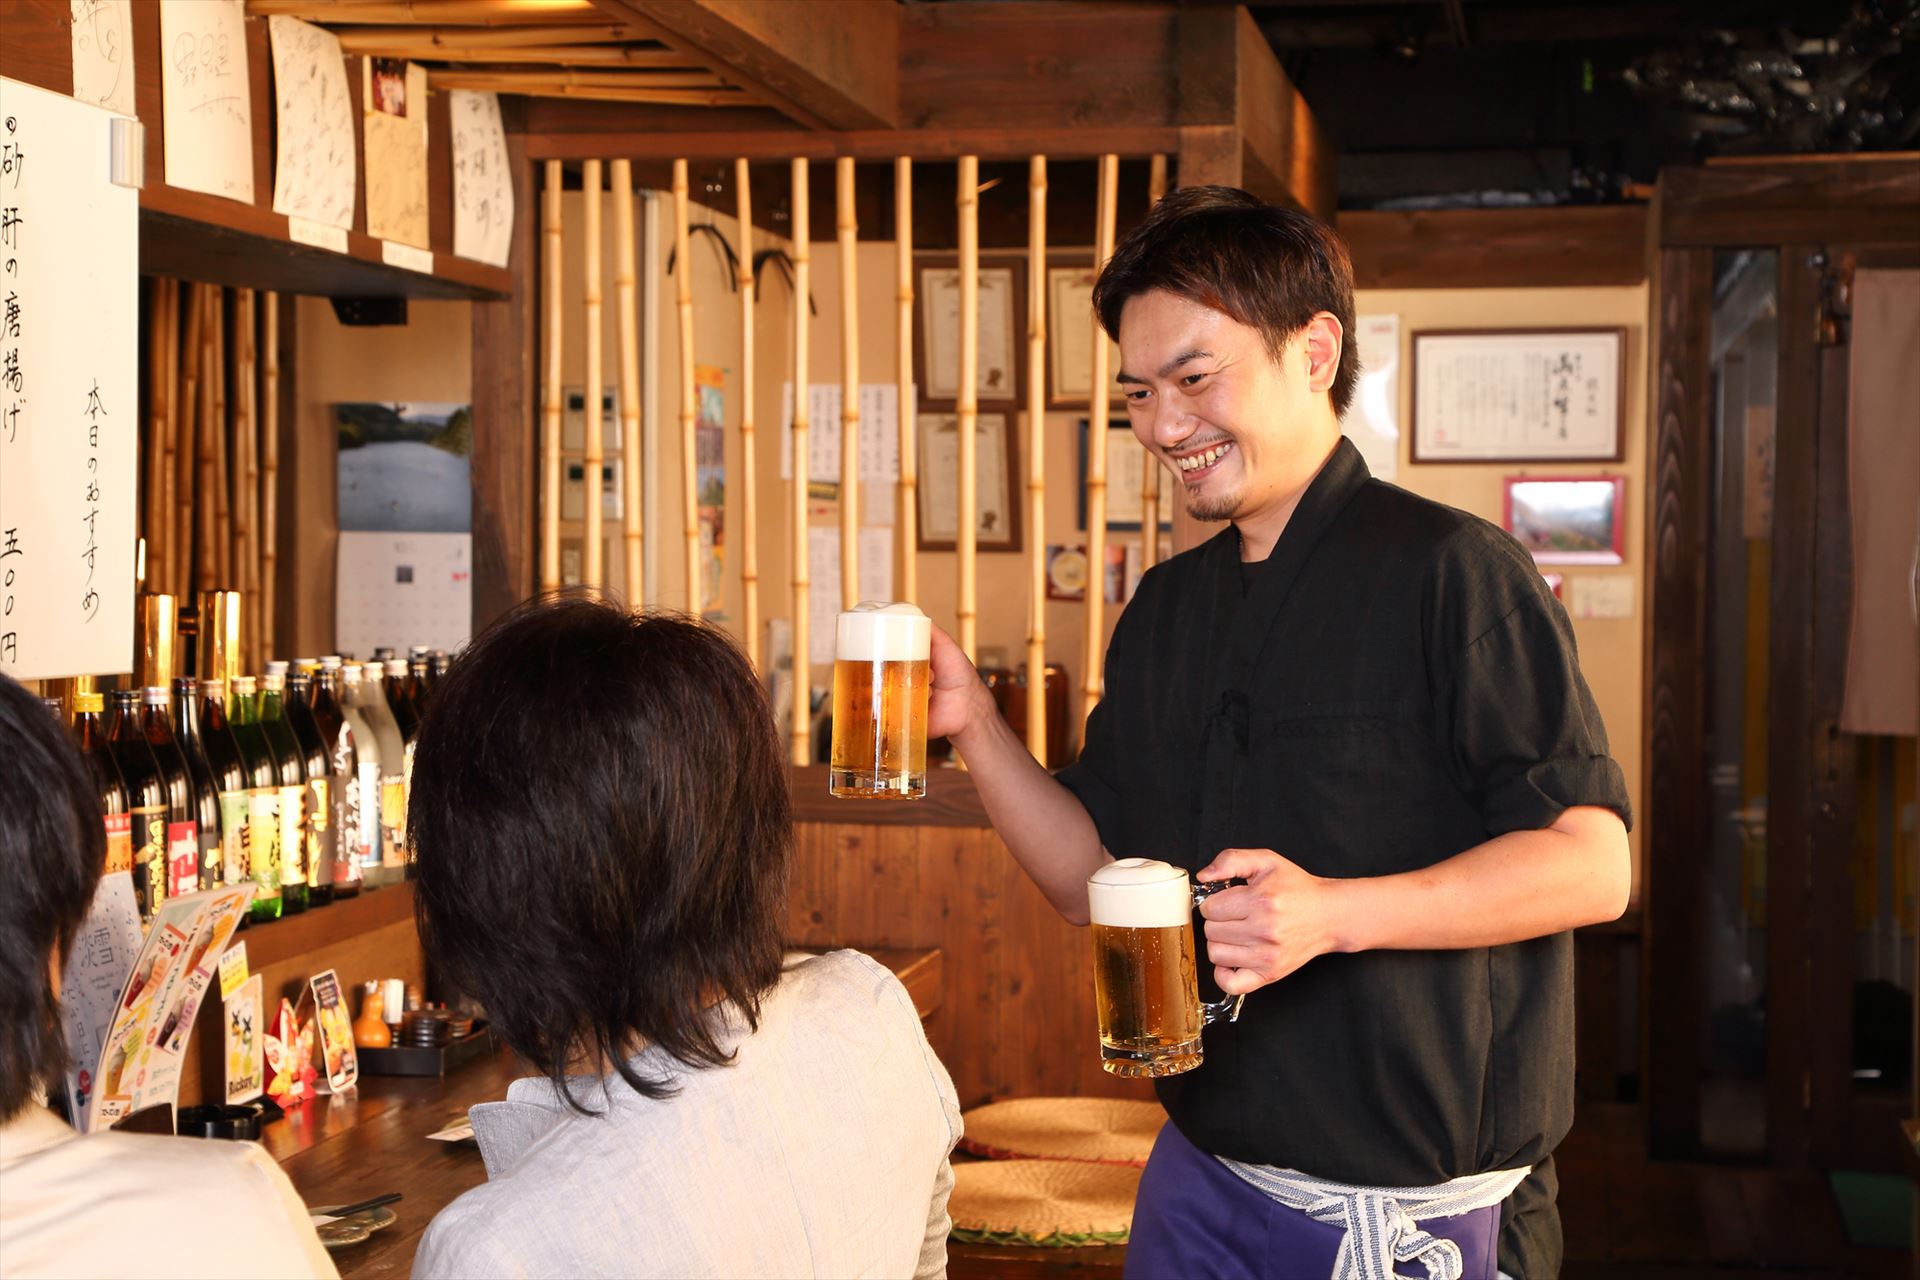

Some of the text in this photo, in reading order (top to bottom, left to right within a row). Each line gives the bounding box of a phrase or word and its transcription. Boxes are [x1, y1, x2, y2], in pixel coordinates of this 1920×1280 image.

[82, 379, 107, 623] 本日のおすすめ
